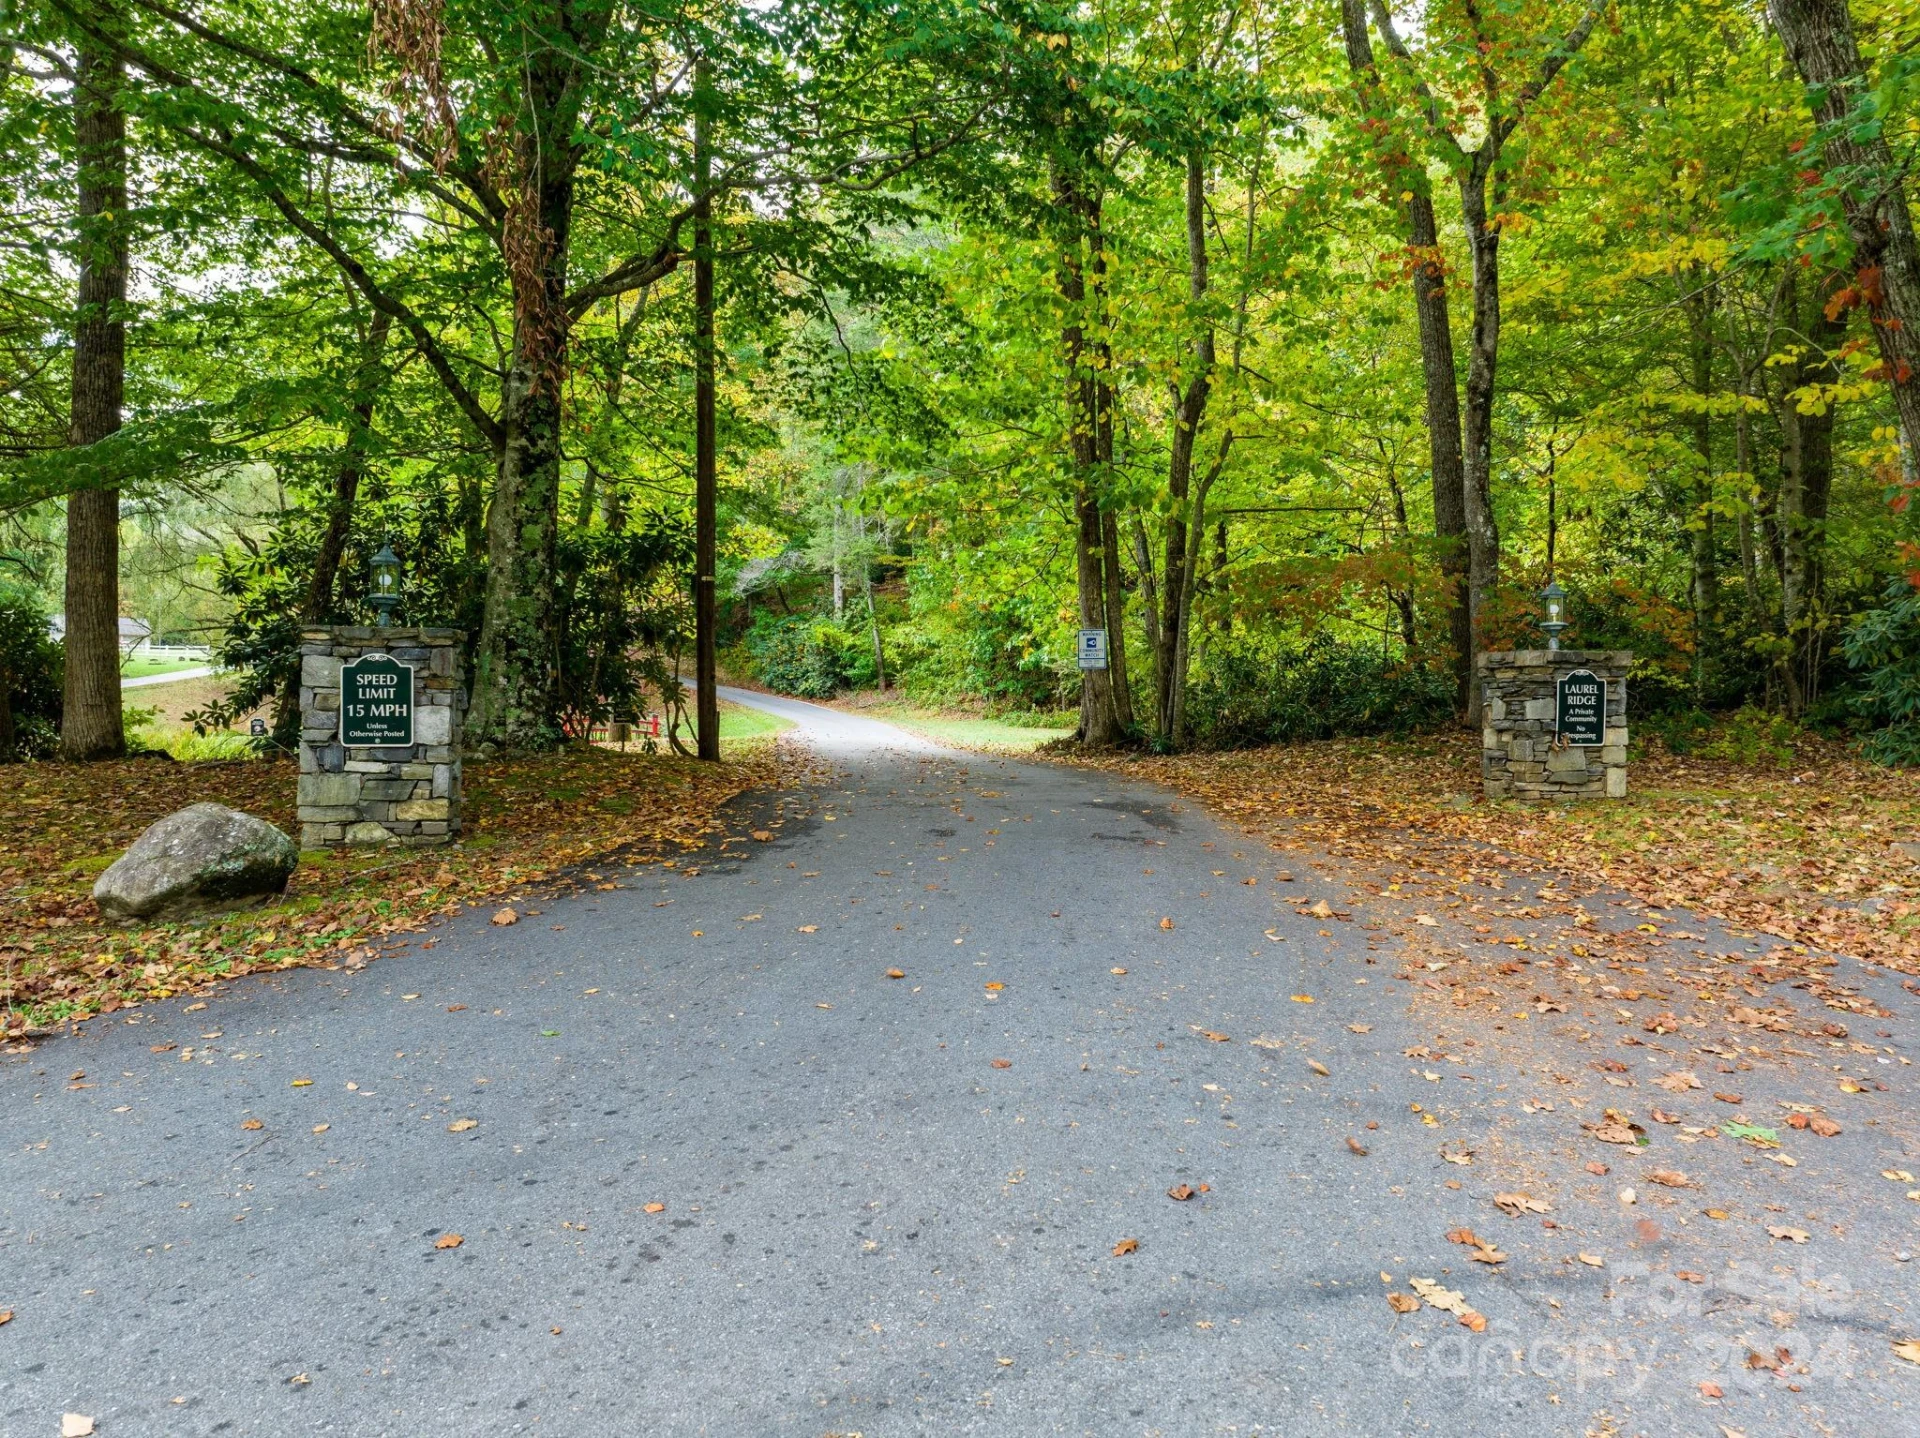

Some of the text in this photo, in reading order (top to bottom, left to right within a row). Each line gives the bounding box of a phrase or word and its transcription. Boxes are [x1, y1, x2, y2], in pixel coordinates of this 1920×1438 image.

[356, 674, 397, 685] SPEED
[358, 688, 396, 699] LIMIT
[1565, 684, 1599, 694] LAUREL
[1567, 695, 1597, 705] RIDGE
[347, 704, 407, 717] 15 MPH
[1565, 715, 1597, 723] Community
